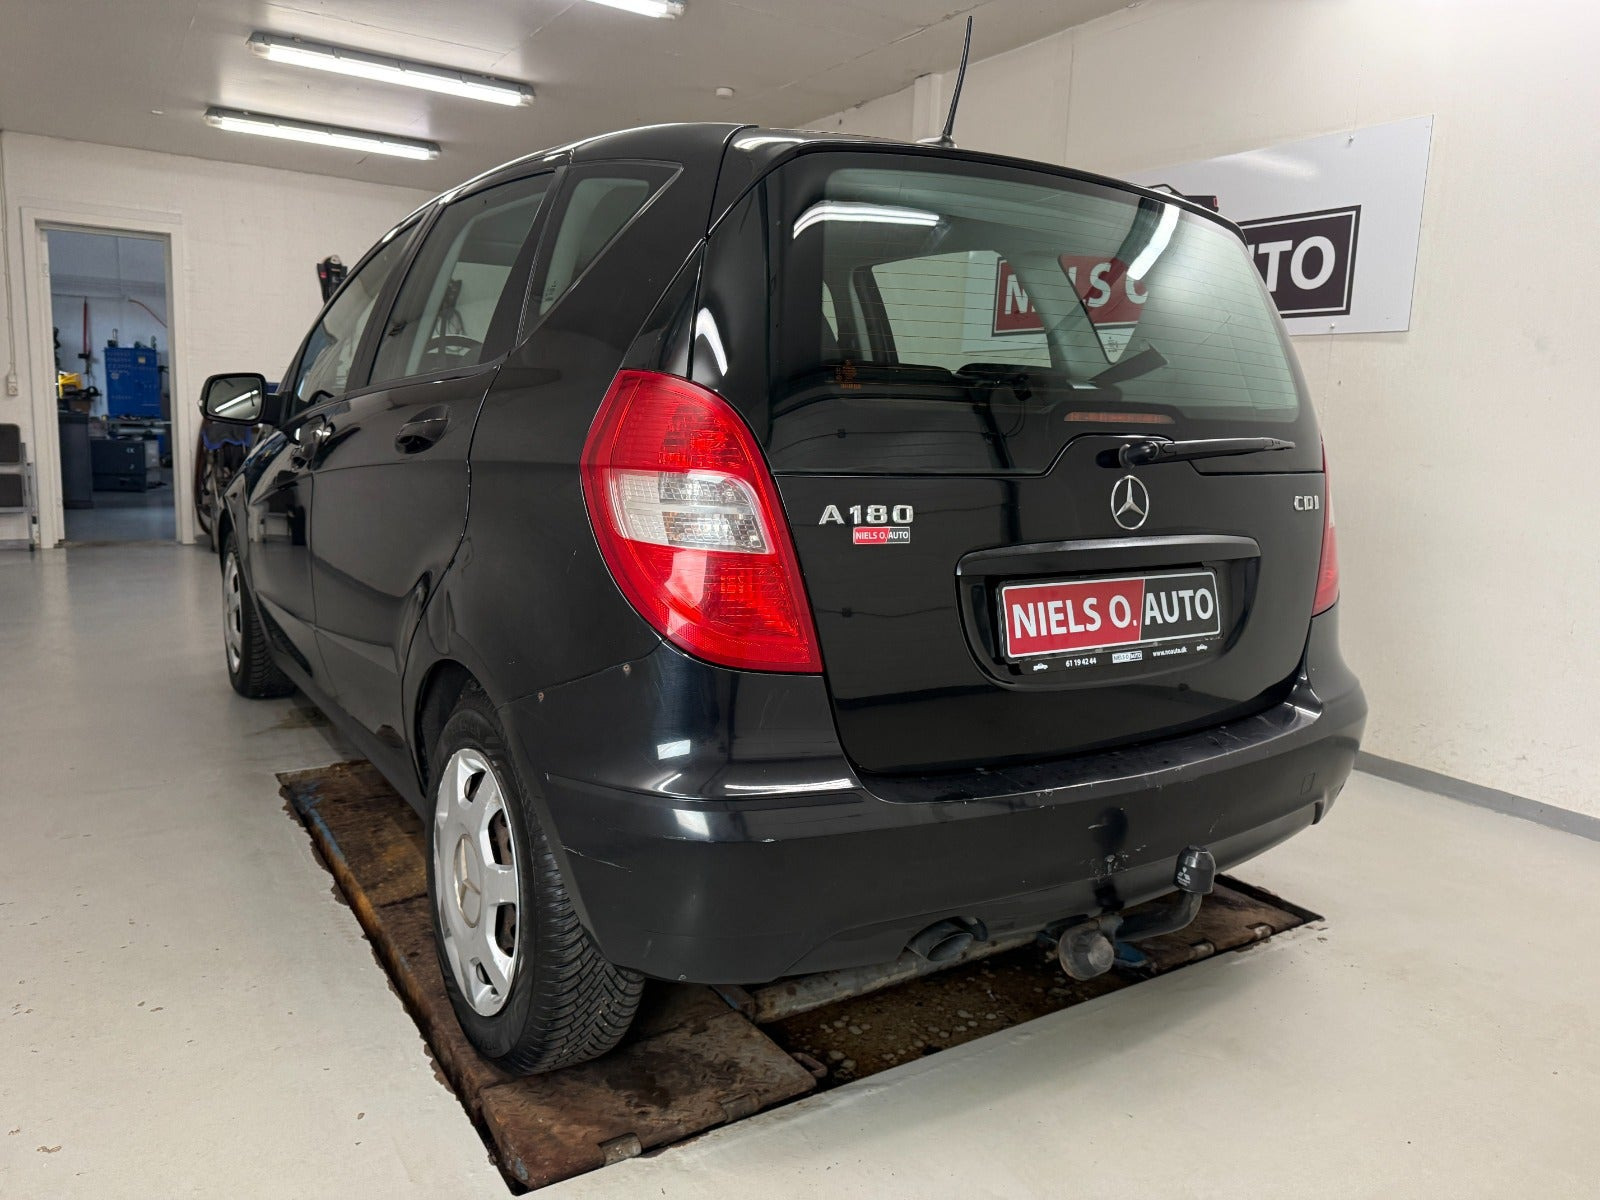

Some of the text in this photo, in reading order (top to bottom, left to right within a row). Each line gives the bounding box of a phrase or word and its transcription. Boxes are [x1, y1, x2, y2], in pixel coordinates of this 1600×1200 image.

[1247, 236, 1336, 293] TO
[1293, 495, 1320, 511] CDI
[855, 531, 878, 540] NIELS
[888, 531, 909, 539] AUTO
[1012, 588, 1214, 639] NIELS O. AUTO
[1065, 659, 1073, 668] 61
